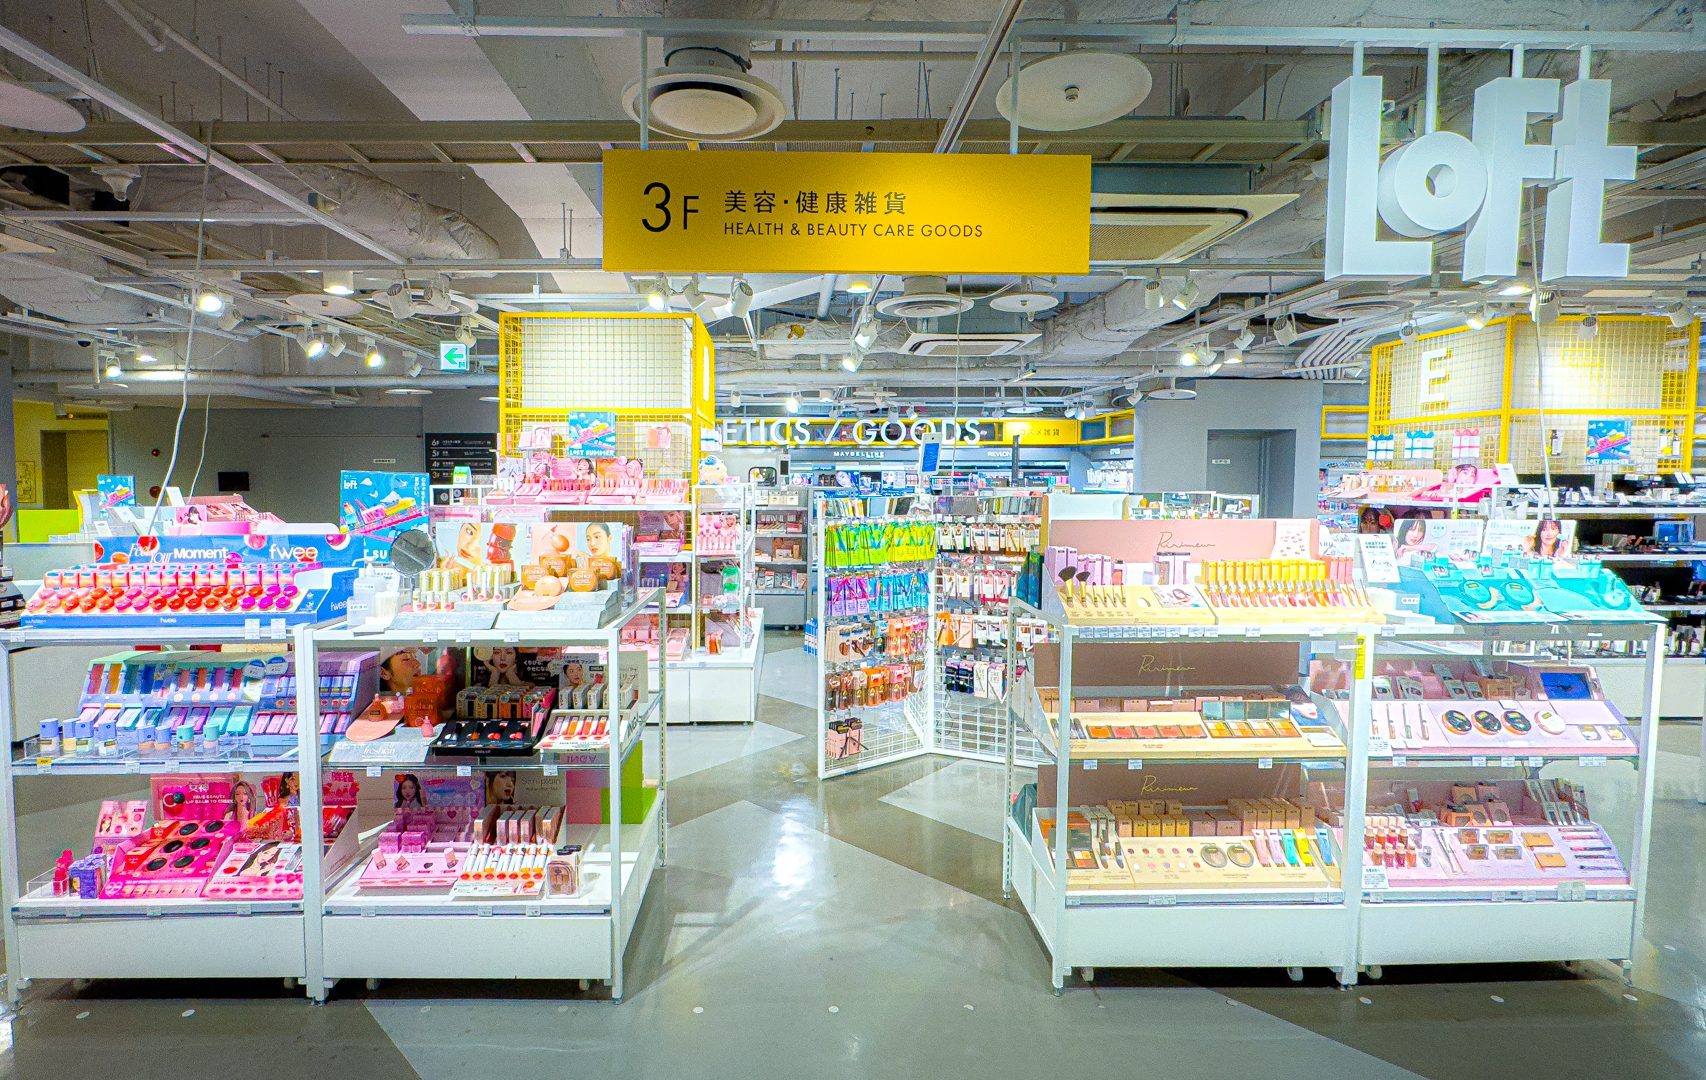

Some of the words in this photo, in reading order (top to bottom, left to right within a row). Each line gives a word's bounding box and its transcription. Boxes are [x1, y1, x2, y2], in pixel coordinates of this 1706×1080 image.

[724, 222, 784, 236] HEALTH
[790, 223, 801, 236] &
[807, 223, 868, 237] BEAUTY
[873, 224, 915, 237] CARE
[921, 224, 983, 238] GOODS
[852, 417, 981, 447] GOODS
[833, 451, 885, 459] MAYBELLINE
[173, 547, 229, 559] Moment
[269, 543, 318, 560] fwee
